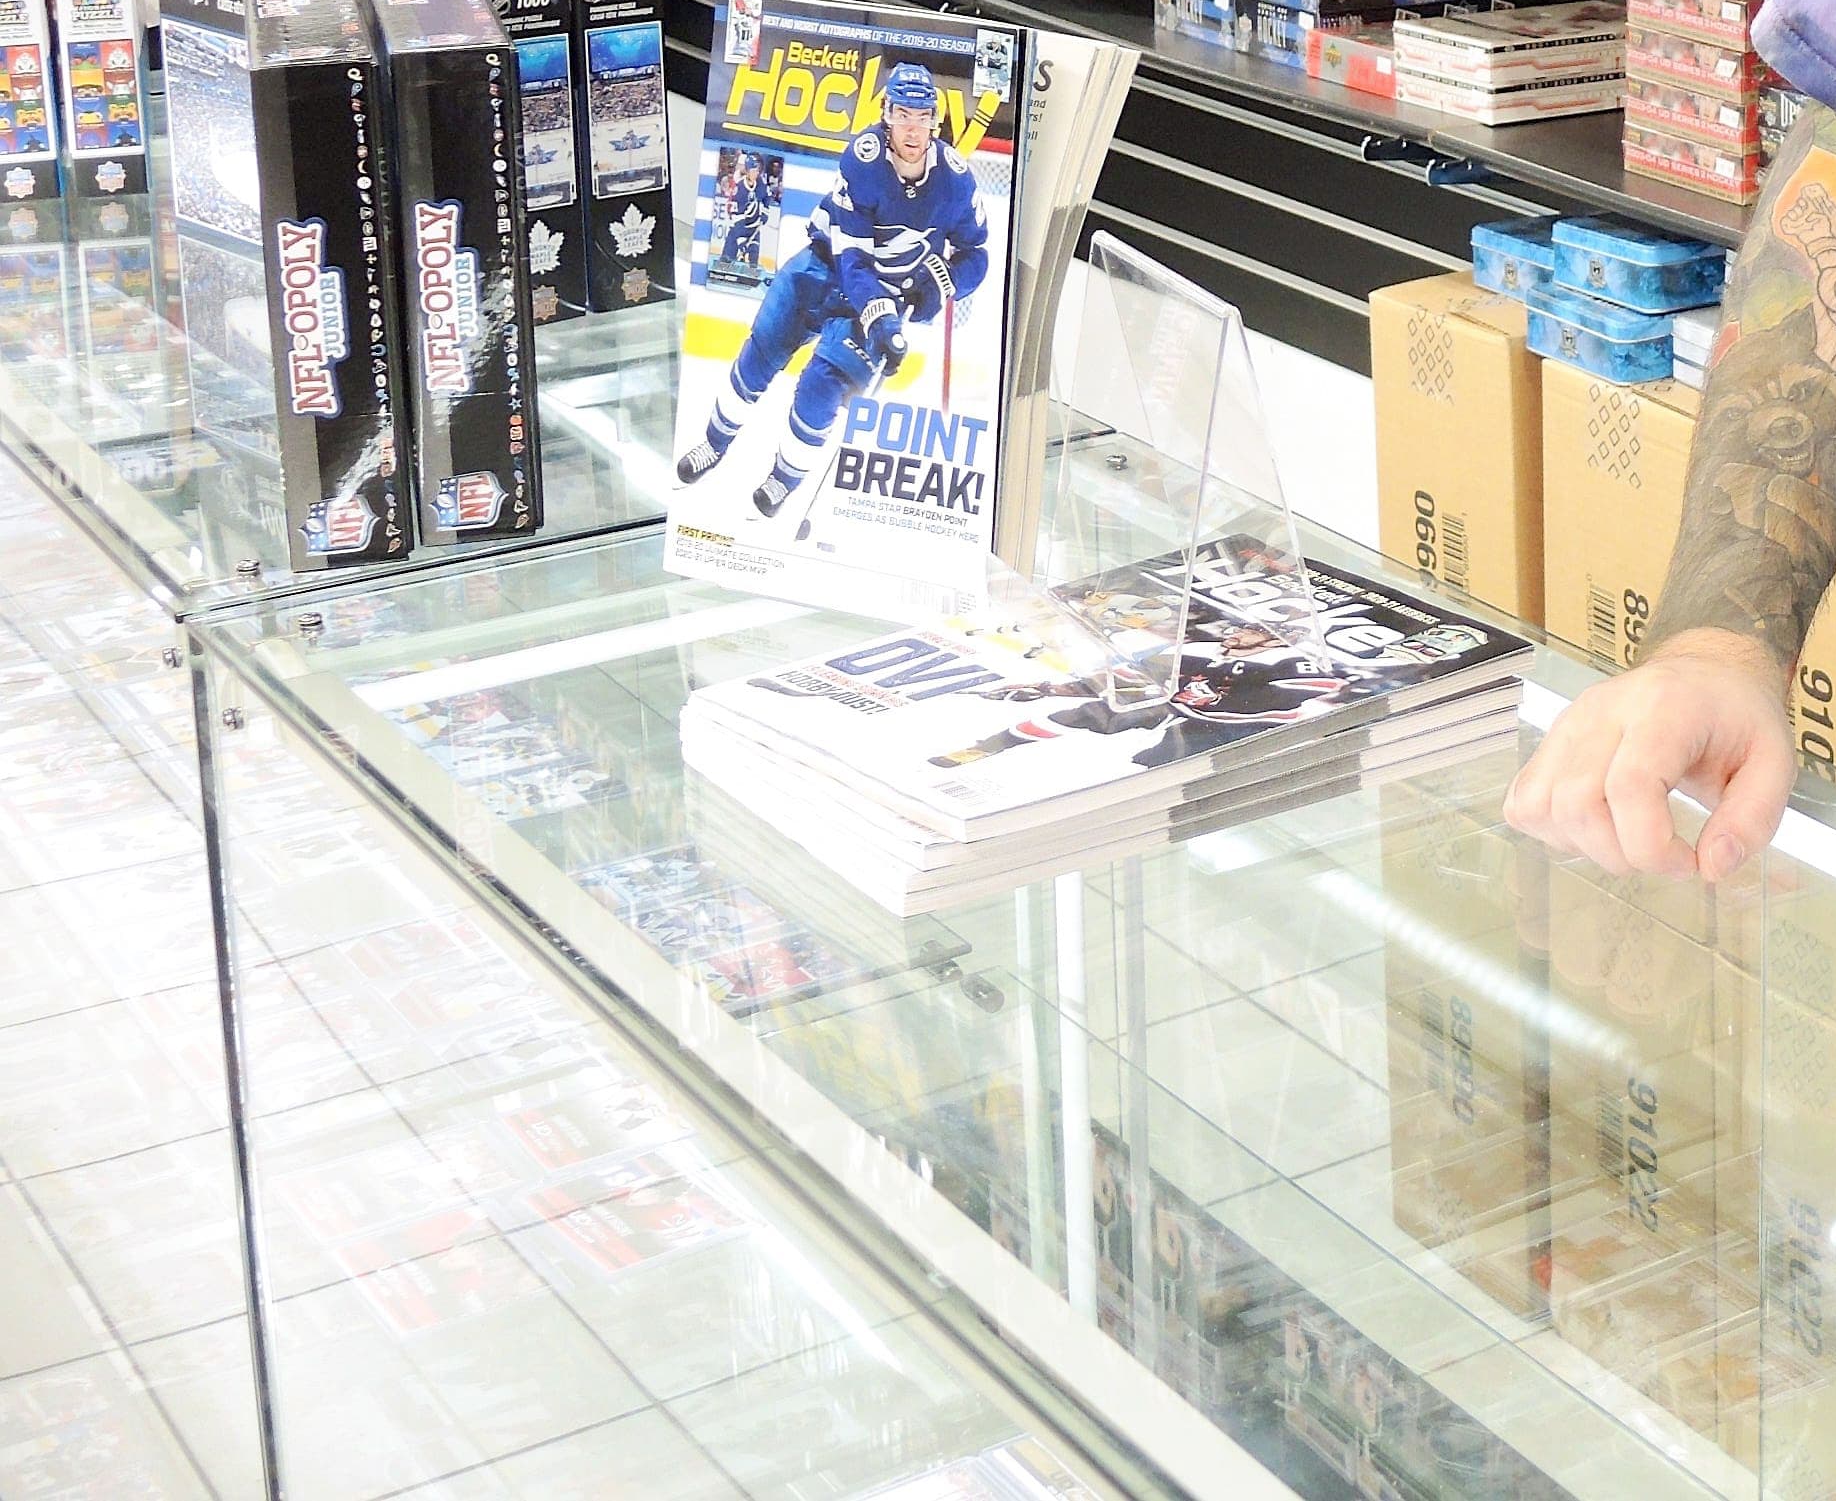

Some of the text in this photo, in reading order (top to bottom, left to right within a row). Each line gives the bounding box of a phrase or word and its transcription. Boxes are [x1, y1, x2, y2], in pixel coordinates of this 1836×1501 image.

[71, 8, 124, 22] PUZZLE
[786, 40, 862, 73] Beckett
[819, 23, 873, 41] AUTOGRAPHS
[873, 30, 885, 43] OF
[884, 31, 901, 45] THE
[902, 33, 939, 49] 2019-20
[939, 38, 976, 54] SEASON
[725, 48, 1004, 161] Hocky
[319, 272, 345, 356] JUNIOR
[456, 257, 476, 337] JUNIOR
[843, 396, 989, 467] POINT
[458, 476, 493, 522] NFL
[833, 446, 985, 516] BREAK!
[677, 524, 700, 539] FIRST
[832, 506, 872, 523] EMERGES
[875, 513, 888, 524] AS
[889, 516, 923, 532] BUBBLE
[924, 522, 957, 538] HOCKEY
[847, 496, 968, 528] TAMPA STAR BRAYDEN POINT
